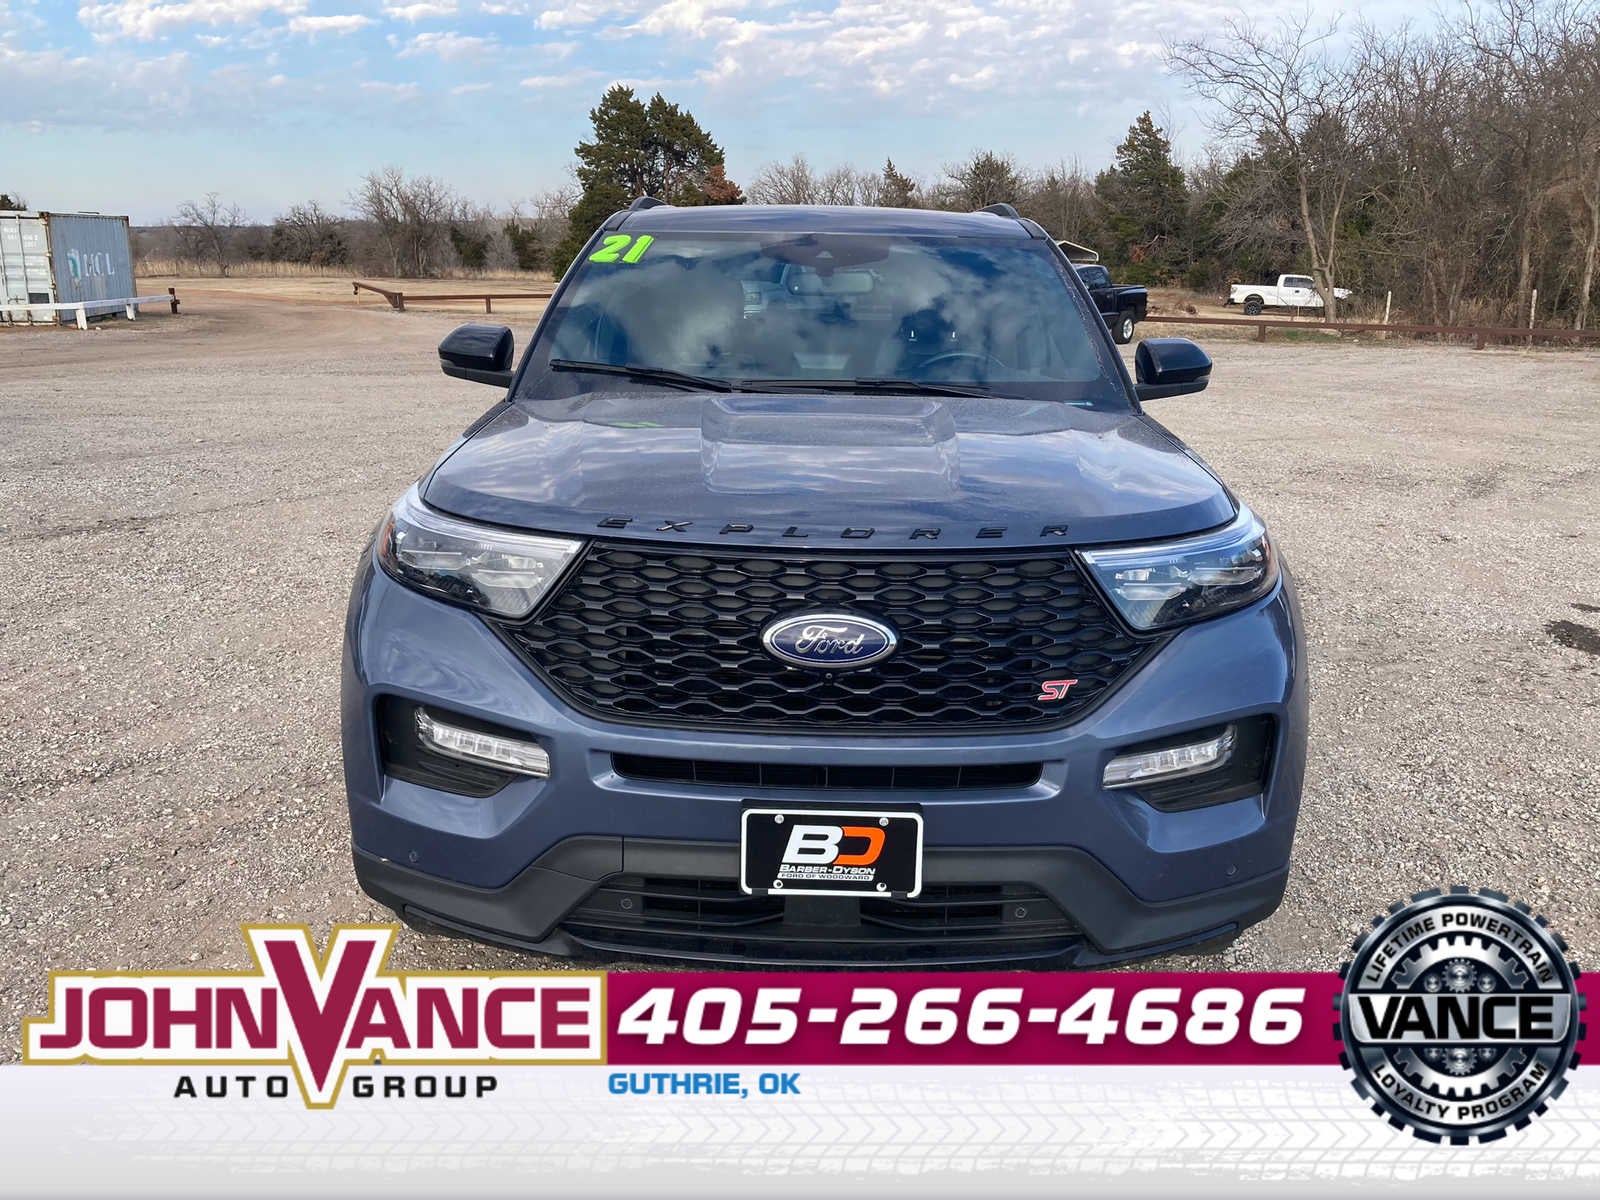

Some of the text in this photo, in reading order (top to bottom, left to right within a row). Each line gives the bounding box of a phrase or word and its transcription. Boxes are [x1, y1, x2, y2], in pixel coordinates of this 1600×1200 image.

[589, 234, 655, 263] 21
[597, 515, 1070, 540] EXPLORER
[794, 624, 864, 655] Ford
[1037, 679, 1078, 701] ST
[779, 864, 876, 875] BARBER-DYSON
